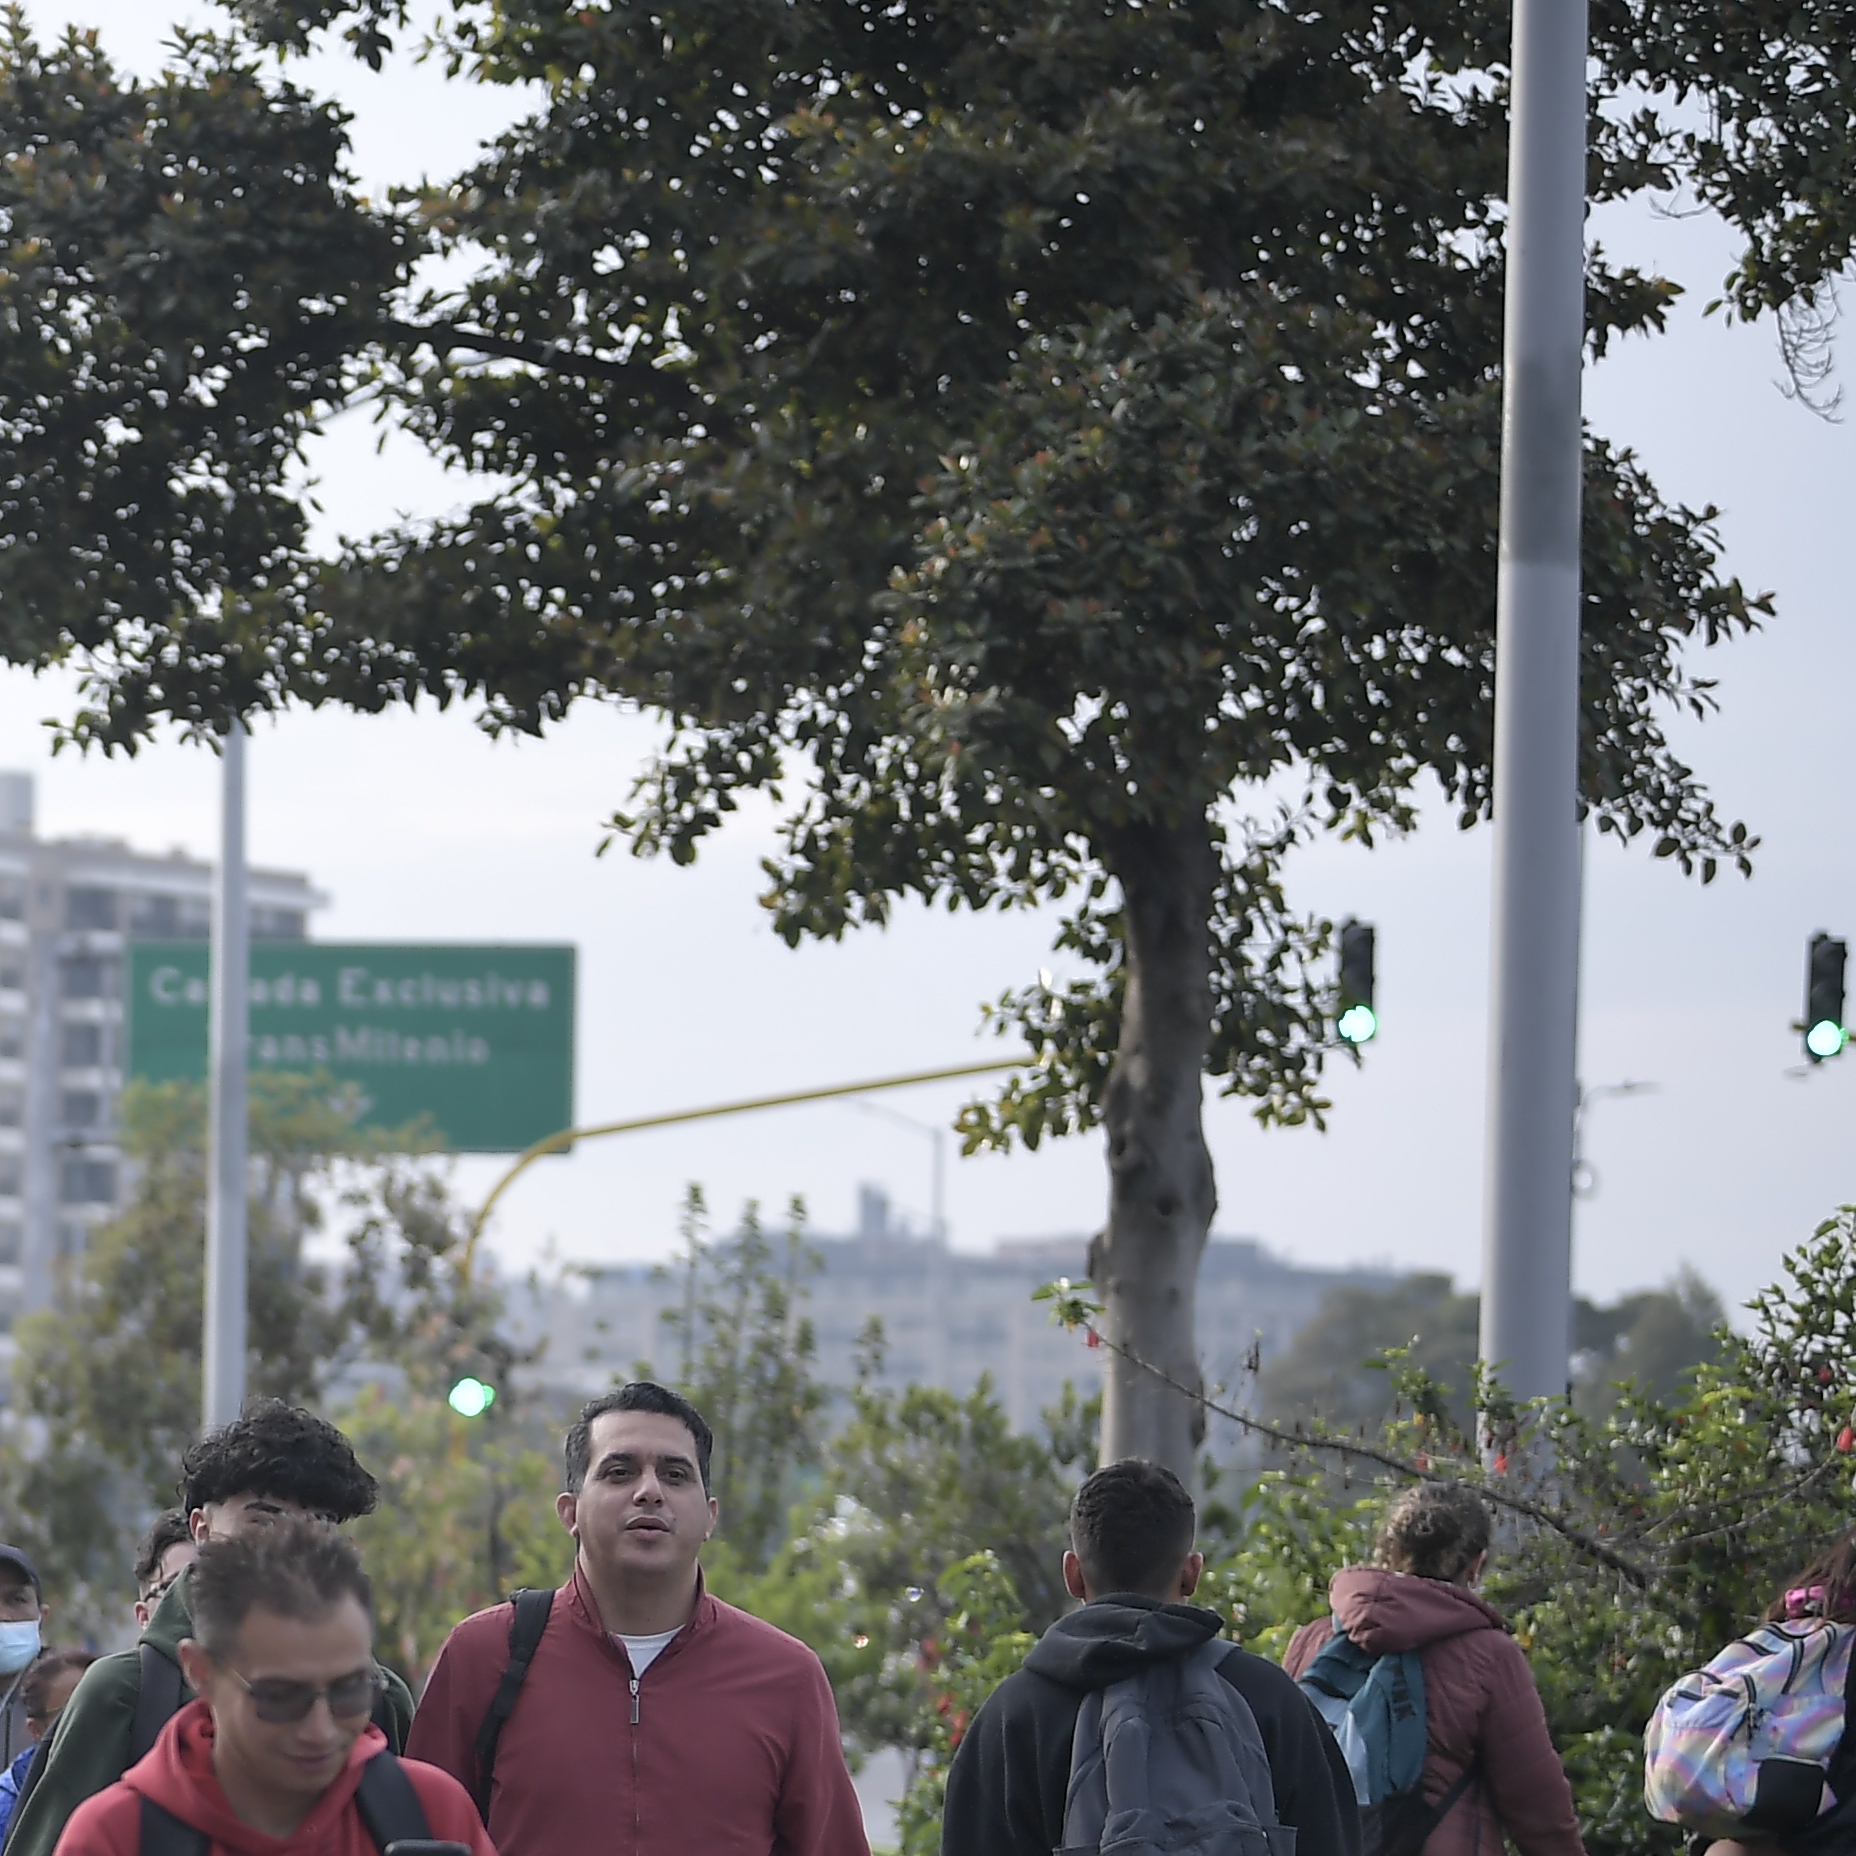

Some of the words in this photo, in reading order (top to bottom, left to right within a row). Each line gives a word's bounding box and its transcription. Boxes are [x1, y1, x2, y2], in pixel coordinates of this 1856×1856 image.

[149, 967, 321, 1006] Caada
[337, 968, 550, 1008] Exclusiva
[246, 1025, 489, 1064] ansMilenio
